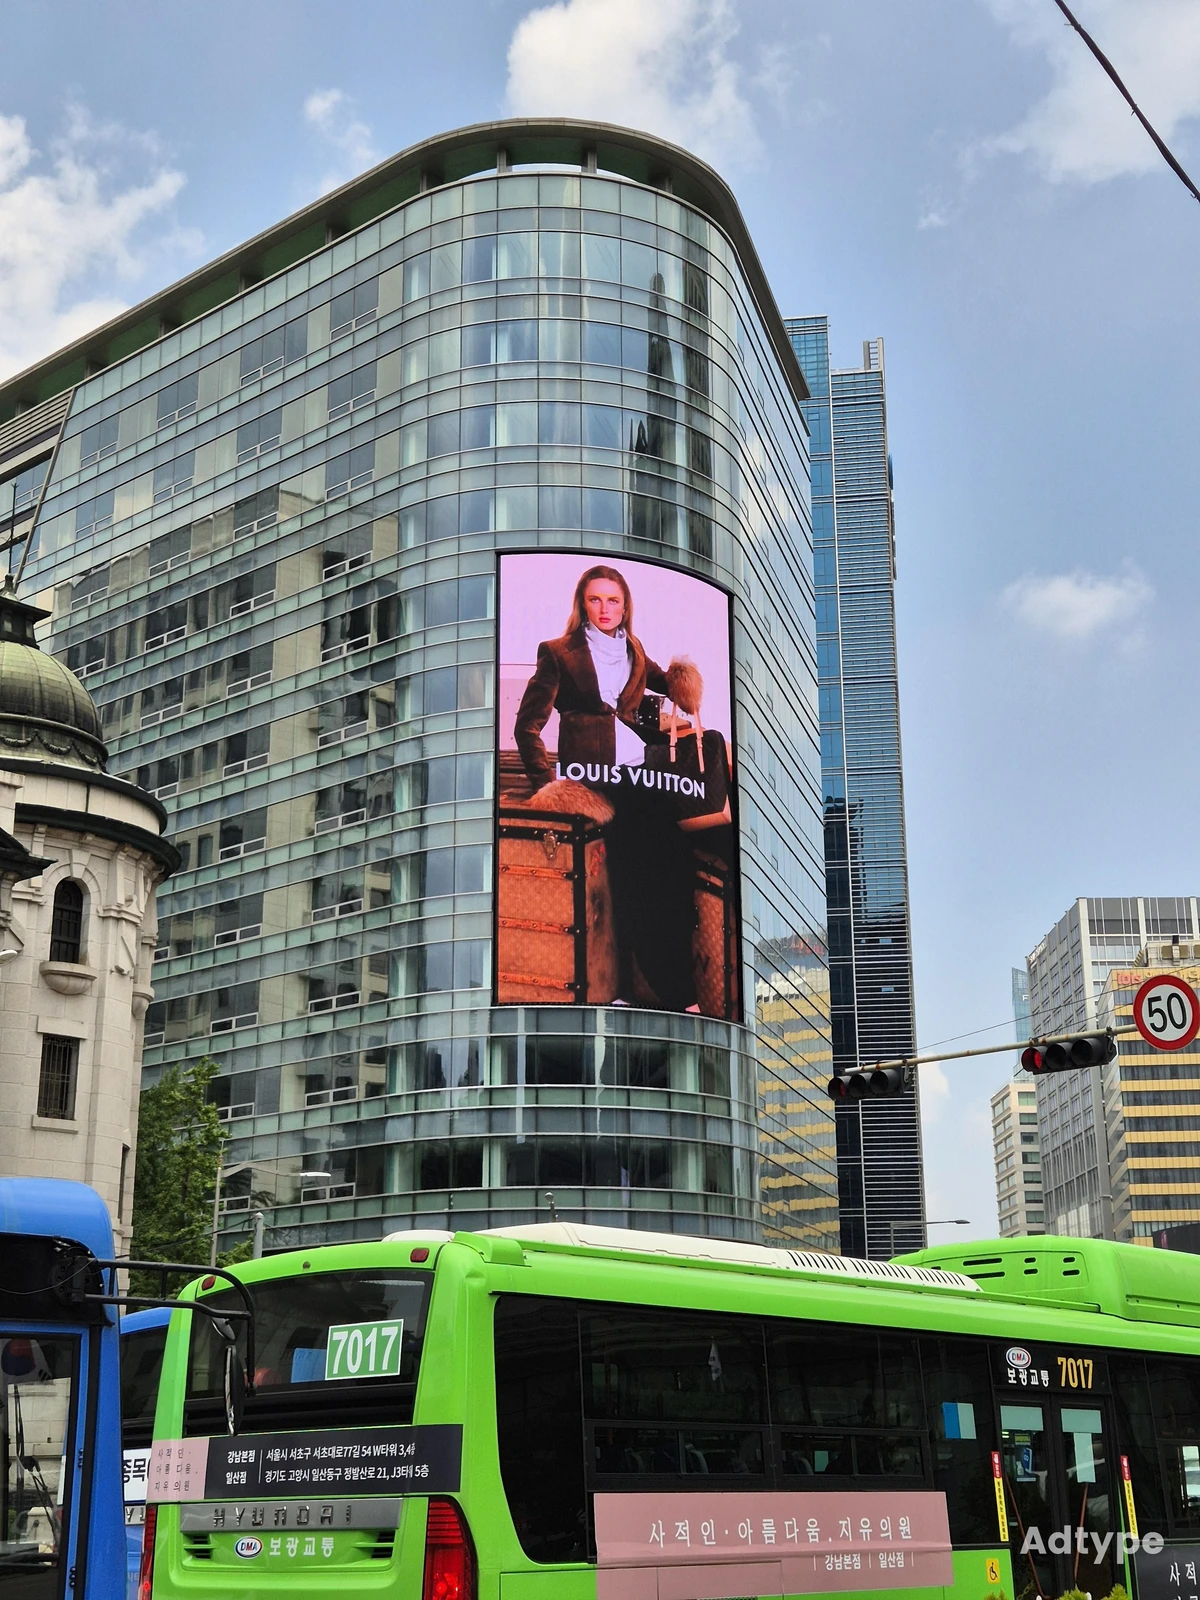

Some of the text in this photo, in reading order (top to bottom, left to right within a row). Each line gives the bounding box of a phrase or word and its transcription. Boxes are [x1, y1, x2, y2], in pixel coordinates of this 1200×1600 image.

[556, 762, 705, 799] LOUIS VUITTON
[1148, 992, 1187, 1033] 50
[332, 1326, 399, 1374] 7017
[1011, 1352, 1027, 1362] DMA
[1007, 1367, 1050, 1388] 보광교통
[1057, 1356, 1093, 1389] 7017
[227, 1449, 256, 1464] 강남본점
[266, 1447, 288, 1461] 서울시
[289, 1447, 311, 1460] 서초구
[312, 1444, 360, 1459] 서초대로77길
[361, 1445, 372, 1457] 54
[226, 1470, 247, 1485] 일산점
[265, 1469, 286, 1483] 경기도
[287, 1468, 310, 1482] 고양시
[311, 1467, 342, 1481] 일산동구
[343, 1466, 375, 1480] 정발산로
[414, 1464, 429, 1478] 5층
[213, 1504, 352, 1527] HYUNDAI
[240, 1541, 258, 1551] DMA
[269, 1537, 334, 1558] 보광교통
[824, 1551, 905, 1571] 강남본점 일산점
